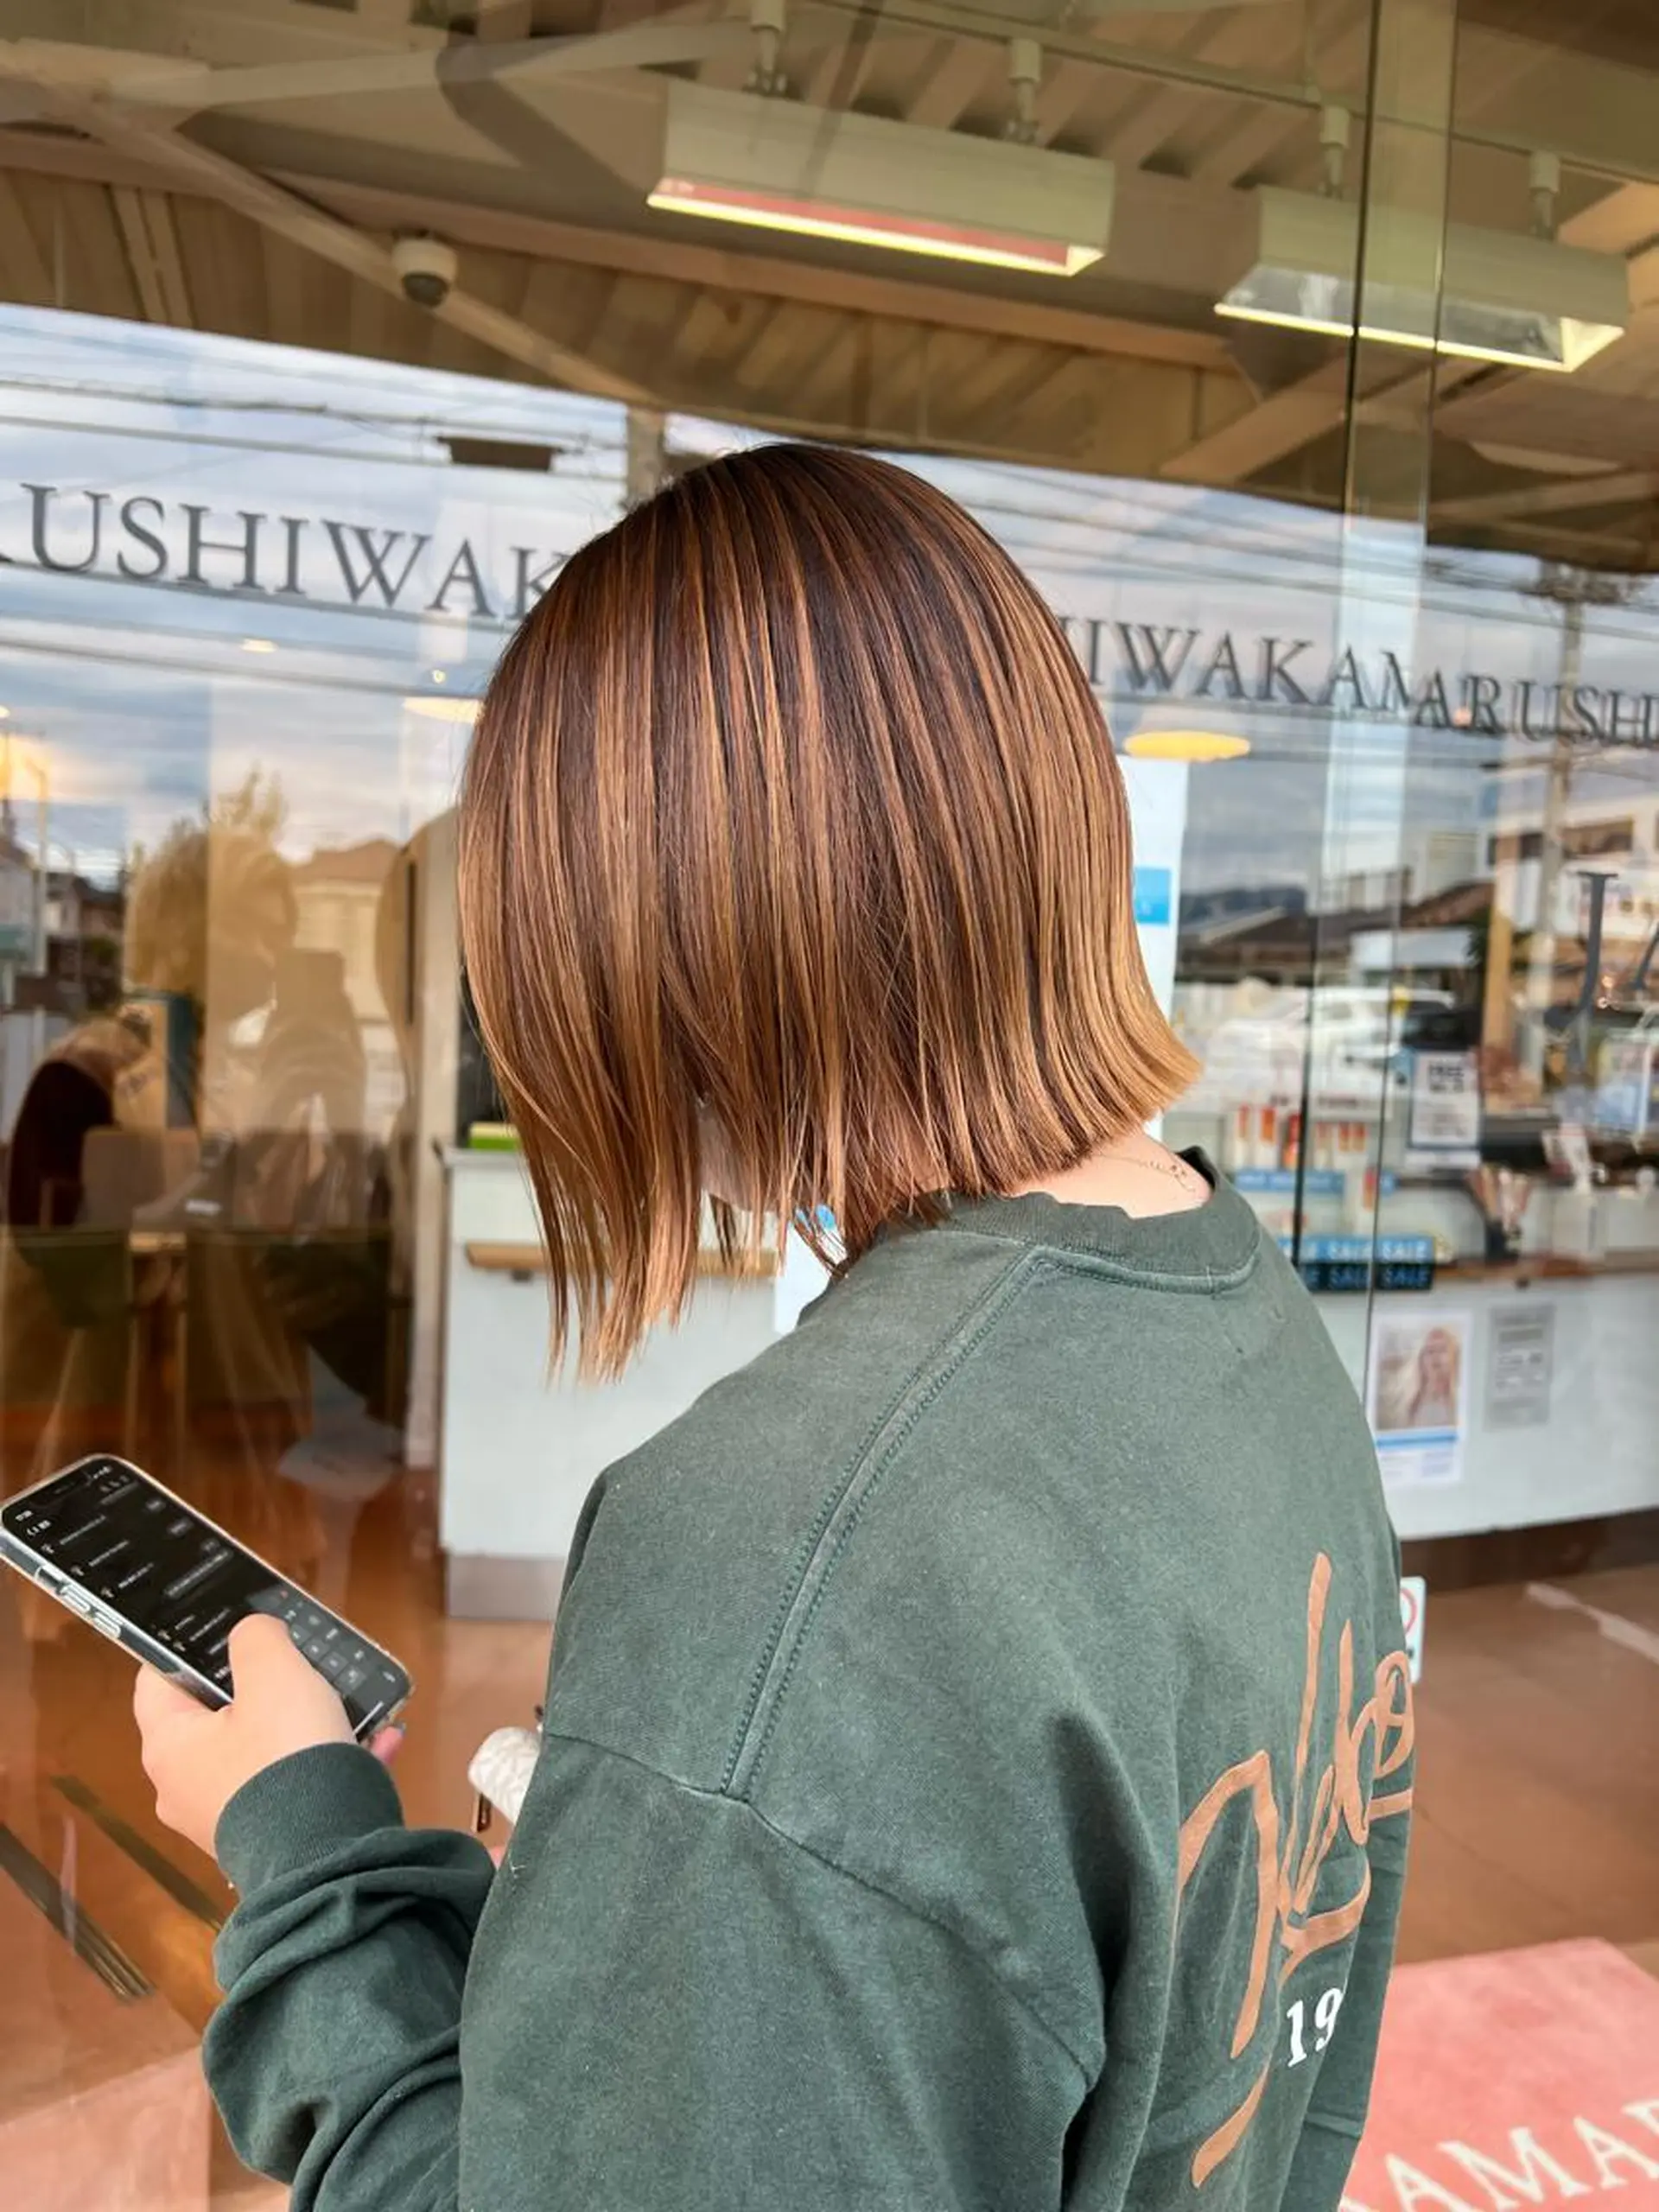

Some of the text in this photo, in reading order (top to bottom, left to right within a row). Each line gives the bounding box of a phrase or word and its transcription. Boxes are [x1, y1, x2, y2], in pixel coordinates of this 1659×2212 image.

[0, 482, 570, 620] USHIWAK
[1286, 1986, 1345, 2068] 19
[1339, 2100, 1659, 2212] AMA
